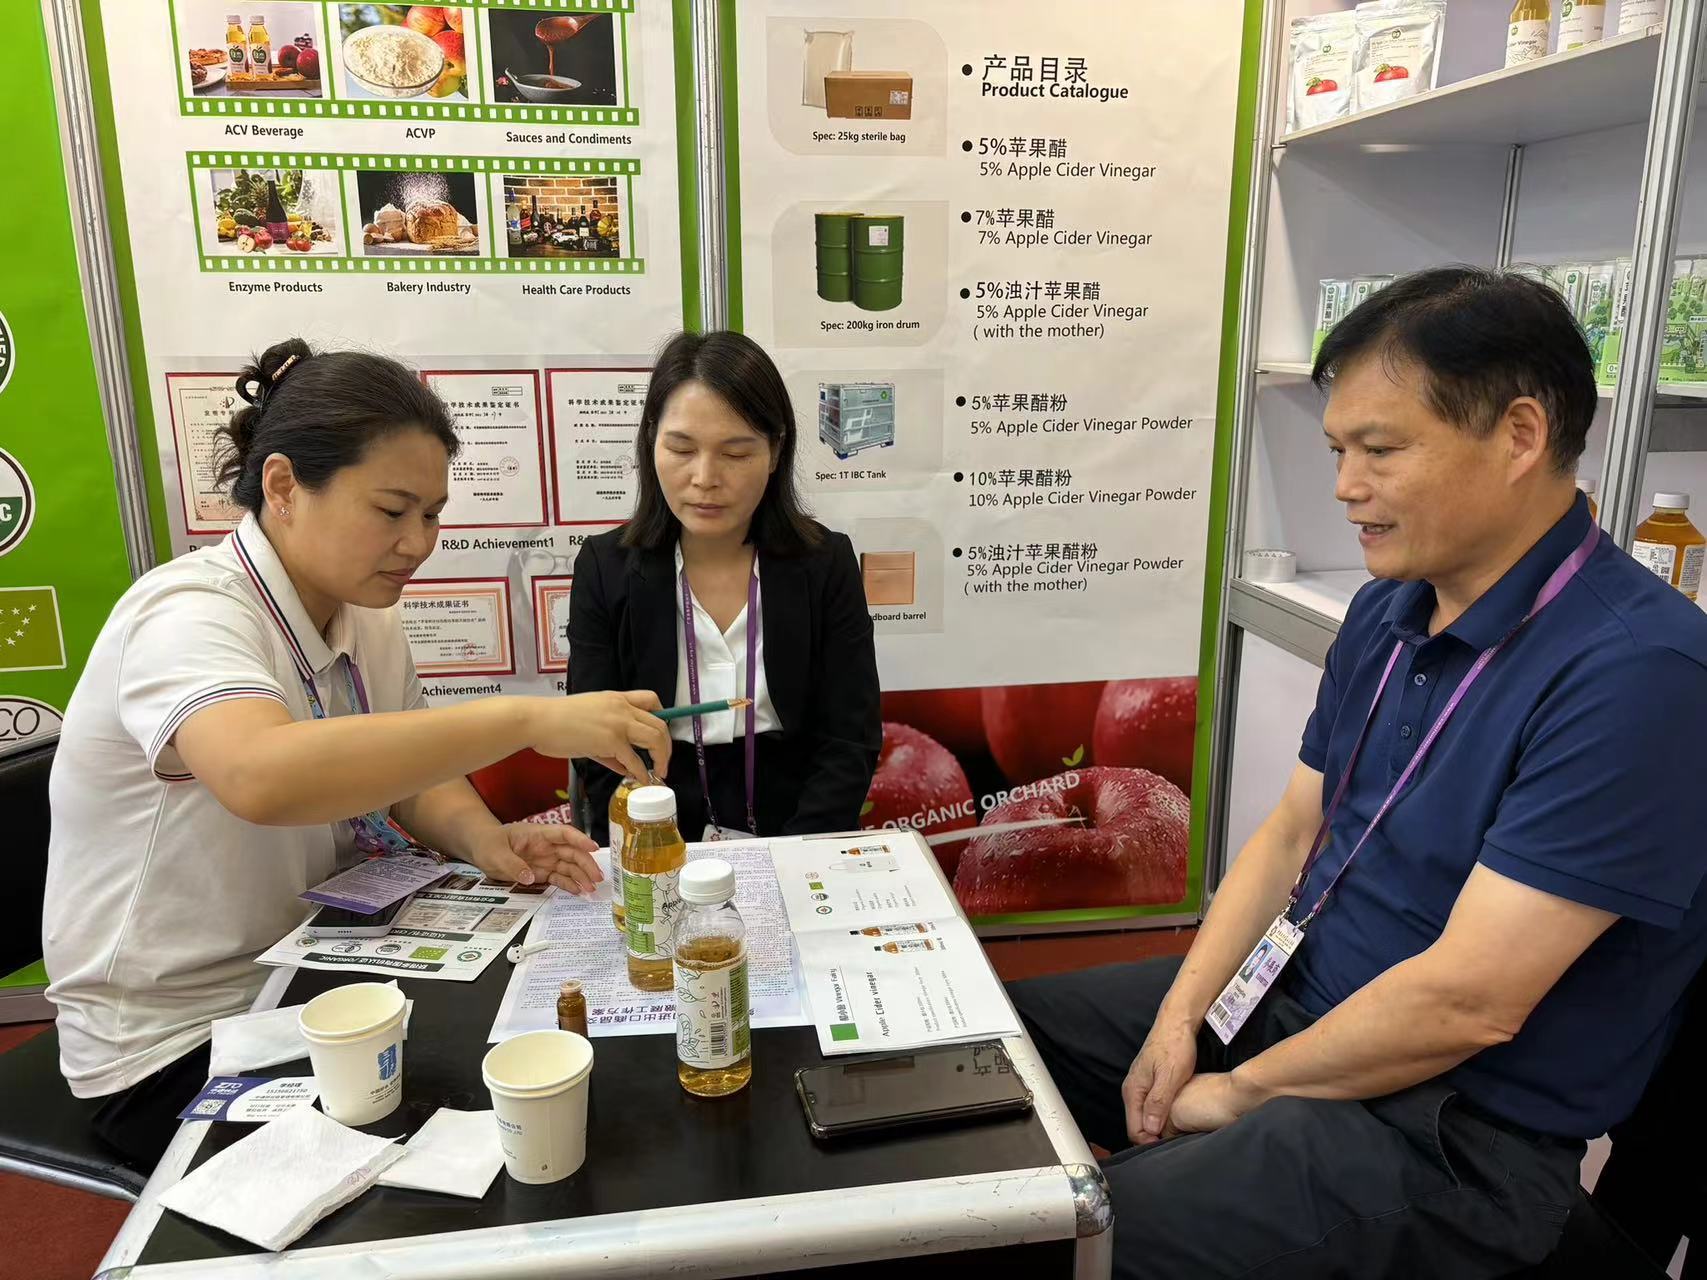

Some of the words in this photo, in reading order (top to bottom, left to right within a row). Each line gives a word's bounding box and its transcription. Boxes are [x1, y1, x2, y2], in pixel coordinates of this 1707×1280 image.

[983, 54, 1088, 85] 产品目录
[983, 82, 1044, 97] Product
[1050, 82, 1128, 102] Catalogue
[225, 125, 247, 135] ACV
[252, 125, 303, 139] Beverage
[406, 128, 435, 138] ACVP
[507, 132, 542, 142] Sauces
[546, 133, 565, 143] and
[569, 133, 631, 144] Condiments
[813, 132, 835, 142] Spec:
[838, 132, 858, 143] 25kg
[862, 132, 887, 140] sterile
[890, 132, 905, 143] bag
[979, 137, 1067, 158] 5%苹果醋
[980, 162, 1002, 176] 5%
[1008, 162, 1051, 180] Apple
[1057, 162, 1095, 176] Cider
[1100, 163, 1156, 181] Vinegar
[976, 208, 1054, 228] 7%苹果醋
[979, 231, 1000, 244] 7%
[1006, 231, 1048, 248] Apple
[1054, 231, 1092, 244] Cider
[1097, 231, 1152, 248] Vinegar
[229, 282, 270, 294] Enzyme
[274, 282, 322, 292] Products
[387, 282, 423, 294] Bakery
[427, 282, 470, 294] Industry
[523, 285, 556, 294] Health
[560, 285, 582, 294] Care
[586, 285, 630, 294] Products
[976, 281, 1100, 300] 5%浊汁苹果醋
[977, 305, 998, 318] 5%
[1004, 304, 1046, 322] Apple
[1051, 304, 1089, 317] Cider
[1094, 304, 1148, 320] Vinegar
[821, 321, 844, 332] Spec:
[847, 321, 873, 331] 200kg
[877, 320, 893, 328] iron
[897, 320, 919, 328] drum
[1019, 324, 1042, 337] the
[1048, 323, 1104, 338] mother)
[972, 394, 1067, 412] 5%苹果醋粉
[971, 421, 991, 434] 5%
[997, 420, 1037, 436] Apple
[1043, 419, 1079, 432] Cider
[1084, 418, 1137, 434] Vinegar
[1142, 416, 1192, 429] Powder
[816, 472, 836, 481] Spec:
[839, 471, 849, 479] 1T
[867, 470, 886, 478] Tank
[970, 469, 1072, 487] 10%苹果醋粉
[970, 494, 998, 506] 10%
[1003, 492, 1043, 508] Apple
[1048, 491, 1084, 504] Cider
[1089, 490, 1141, 505] Vinegar
[1146, 488, 1196, 500] Powder
[442, 540, 469, 549] R&D
[473, 537, 553, 549] Achievement1
[569, 535, 585, 546] R&
[968, 544, 1098, 561] 5%浊汁苹果醋粉
[967, 564, 988, 577] 5%
[992, 562, 1032, 579] Apple
[1036, 561, 1072, 576] Cider
[1077, 560, 1130, 577] Vinegar
[1133, 557, 1184, 570] Powder
[1007, 580, 1029, 592] the
[1034, 578, 1087, 591] mother)
[902, 611, 926, 622] barrel
[422, 683, 502, 696] Achievement4
[882, 798, 976, 831] ORGANIC
[980, 772, 1080, 808] ORCHARD
[866, 972, 878, 996] vinegar
[872, 998, 884, 1015] Cider
